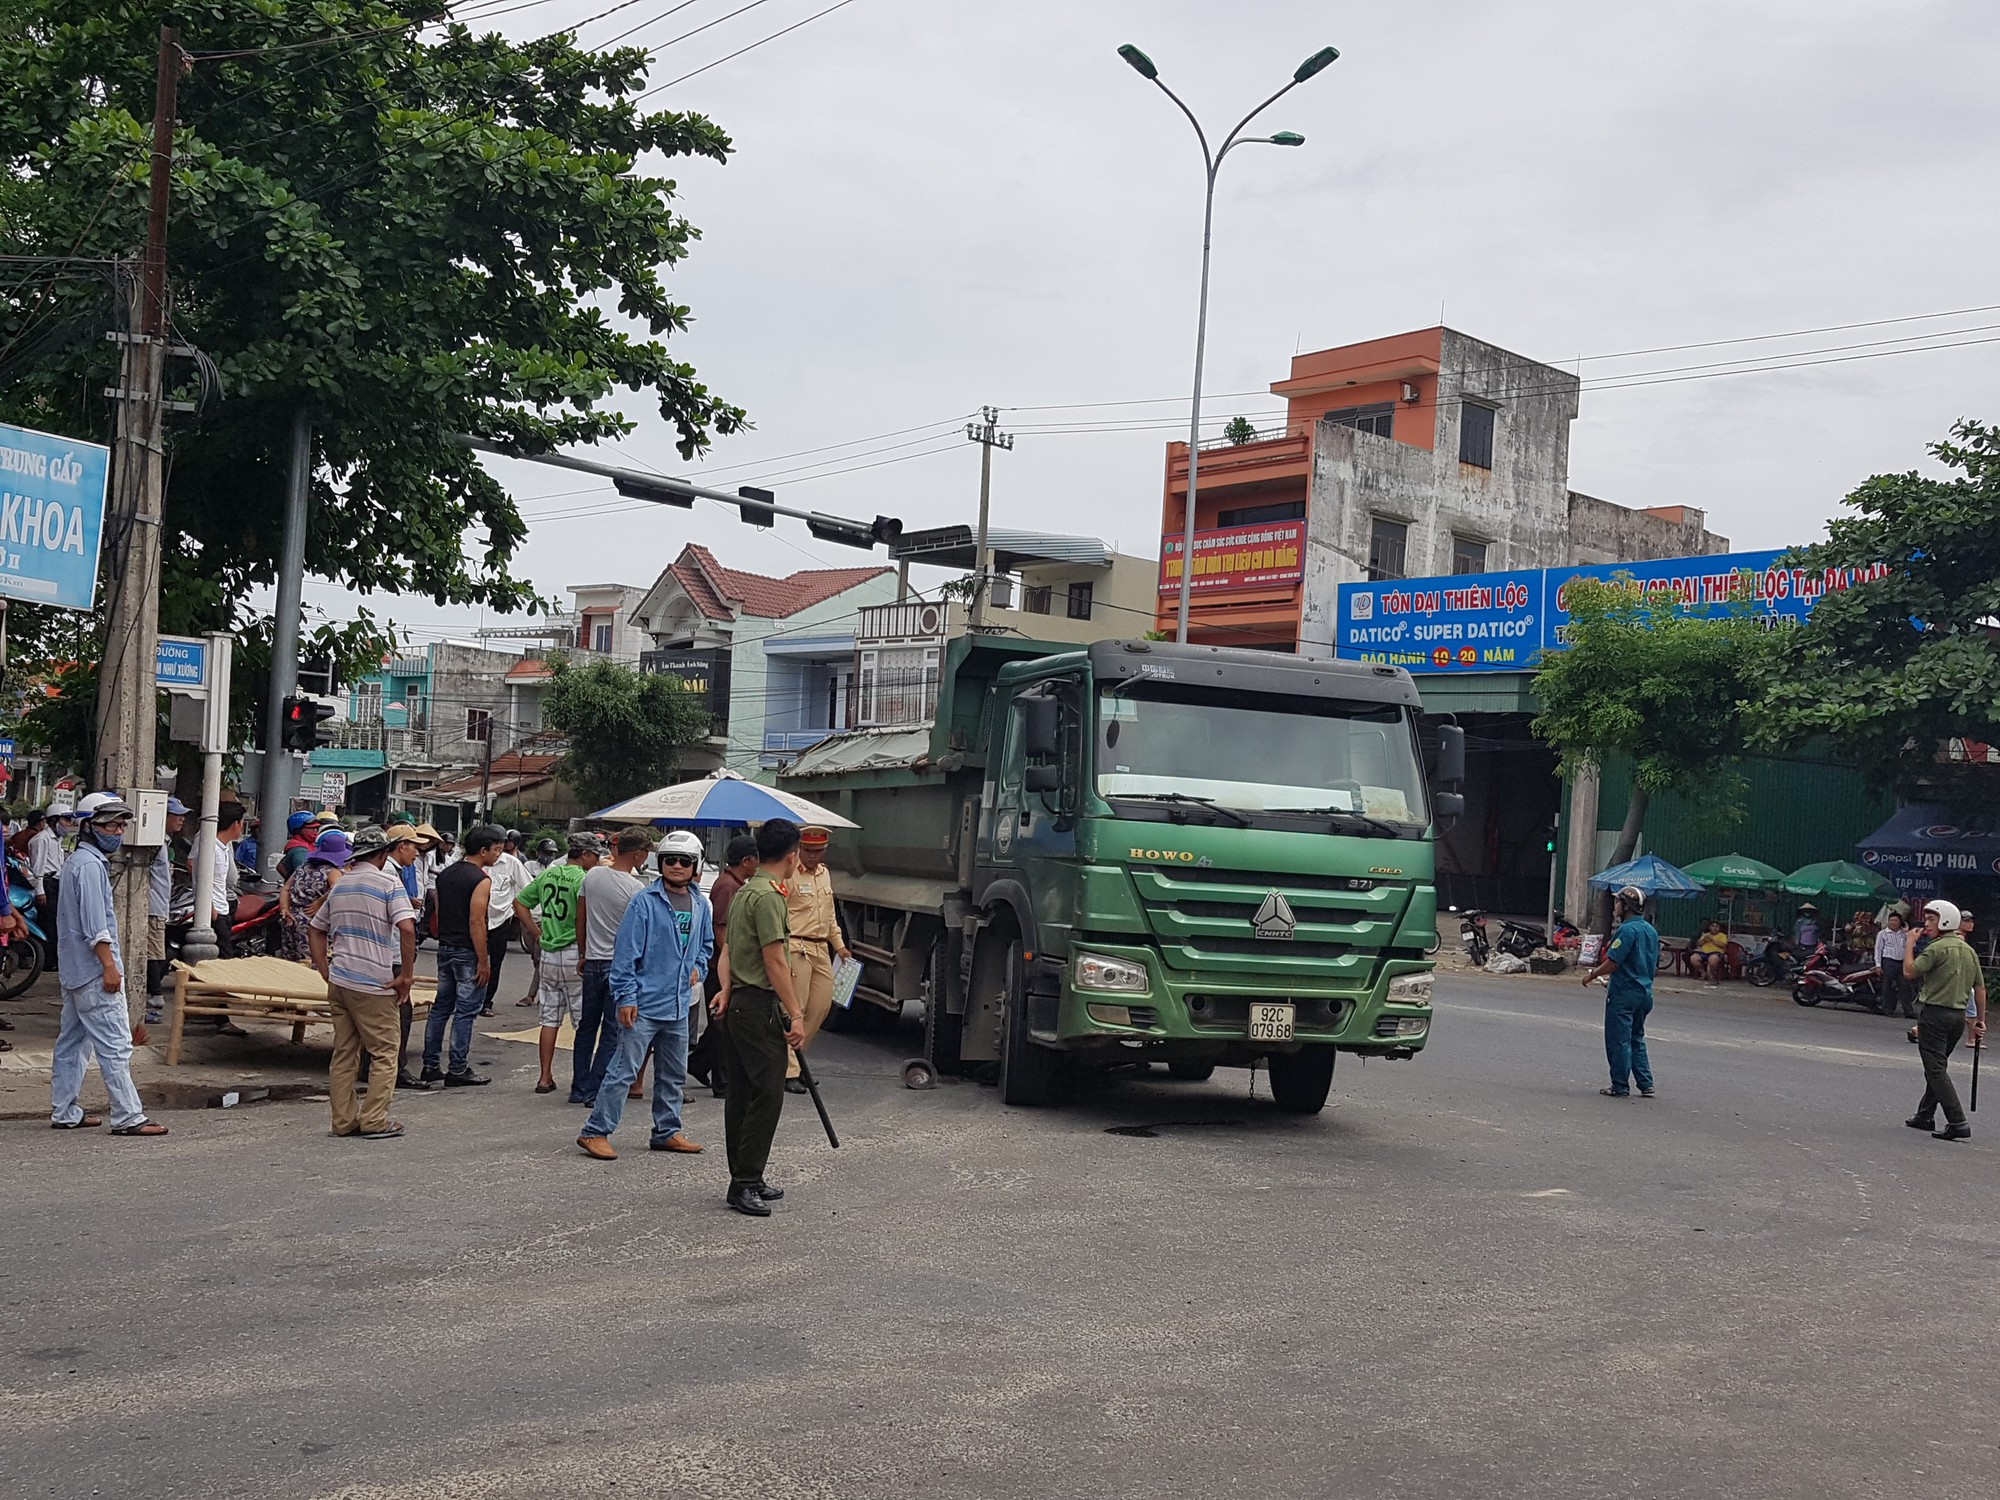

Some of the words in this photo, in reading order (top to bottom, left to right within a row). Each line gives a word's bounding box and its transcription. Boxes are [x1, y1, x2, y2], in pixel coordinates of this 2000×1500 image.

[50, 451, 83, 485] CẤP
[0, 492, 85, 556] KHOA
[1166, 559, 1184, 578] TRUN
[1755, 567, 1788, 607] LỘC
[1381, 589, 1411, 614] TÔN
[1414, 590, 1440, 618] ĐẠI
[1444, 583, 1492, 611] THIÊN
[1495, 581, 1528, 613] LỘC
[1414, 623, 1463, 641] SUPER
[1389, 649, 1426, 664] HÀNH
[1433, 651, 1449, 664] 10
[1460, 650, 1476, 662] 20
[1483, 646, 1514, 662] NĂM
[1129, 848, 1194, 862] HOWO
[1880, 853, 1912, 864] pepsi
[1915, 852, 1943, 870] TẠP
[1369, 866, 1403, 875] GOLD
[1722, 866, 1756, 876] Grab
[1348, 879, 1373, 889] 371
[1829, 875, 1867, 886] Grab
[1895, 877, 1913, 891] TẠP
[542, 883, 569, 921] 25
[1261, 1007, 1284, 1022] 92C
[1251, 1023, 1292, 1038] 079.68
